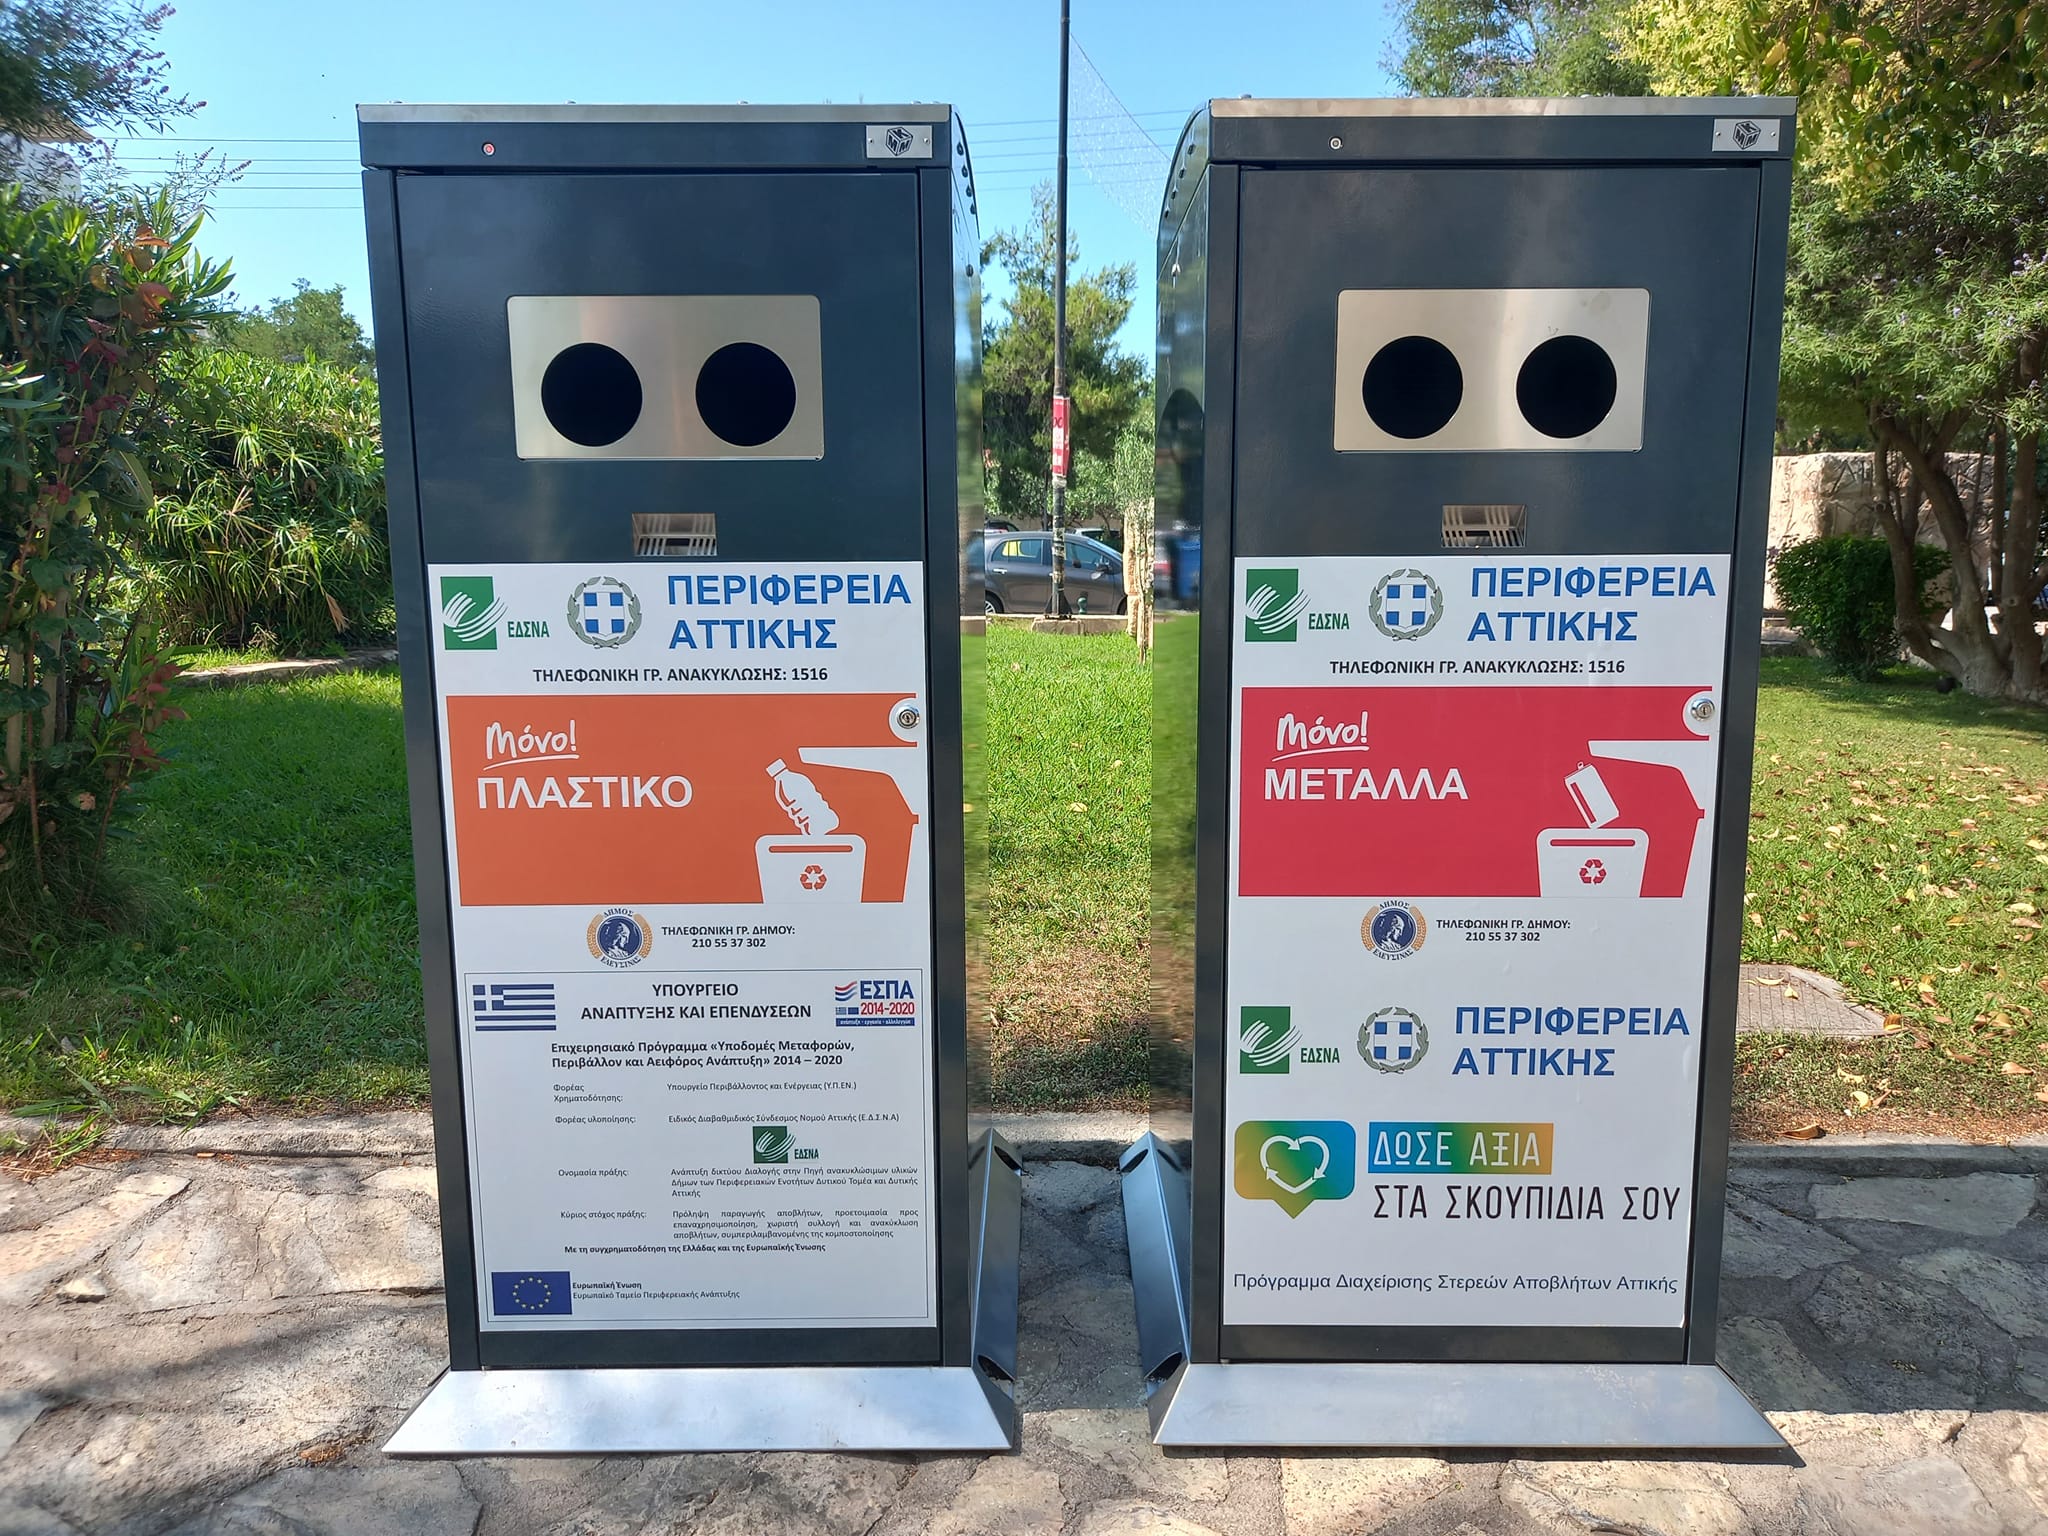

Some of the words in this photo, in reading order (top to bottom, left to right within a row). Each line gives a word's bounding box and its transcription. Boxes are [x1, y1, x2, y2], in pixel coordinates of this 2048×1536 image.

[1472, 567, 1715, 597] ΠΕΡΙΦΕΡΕΙΑ
[668, 575, 911, 605] ΠΕΡΙΦΕΡΕΙΑ
[1309, 613, 1349, 629] ΕΔΣΝΑ
[1467, 612, 1637, 641] ΑΤΤΙΚΗΣ
[508, 621, 549, 637] ΕΔΣΝΑ
[669, 619, 837, 649] ΑΤΤΙΚΗΣ
[1330, 661, 1434, 674] ΤΗΛΕΦΩΝΙΚΗ
[1440, 661, 1458, 673] ΓΡ.
[1463, 661, 1583, 673] ΑΝΑΚΥΚΛΩΣΗΣ:
[1589, 661, 1624, 673] 1516
[533, 669, 638, 682] ΤΗΛΕΦΩΝΙΚΗ
[644, 669, 662, 681] ΓΡ.
[668, 668, 786, 681] ΑΝΑΚΥΚΛΩΣΗΣ:
[792, 668, 827, 680] 1516
[1276, 711, 1369, 752] Μόνο!
[485, 719, 577, 761] Μόνο!
[1264, 768, 1468, 801] ΜΕΤΑΛΛΑ
[477, 774, 693, 809] ΠΛΑΣΤΙΚΟ
[1379, 900, 1411, 910] ΔΗΜΟΣ
[603, 907, 635, 918] ΔΗΜΟΣ
[1436, 920, 1508, 928] ΤΗΛΕΦΩΝΙΚΗ
[1512, 920, 1524, 928] ΓΡ.
[1527, 920, 1570, 928] ΔΗΜΟΥ:
[662, 926, 733, 935] ΤΗΛΕΦΩΝΙΚΗ
[737, 926, 749, 934] ΓΡ.
[753, 926, 795, 934] ΔΗΜΟΥ:
[1466, 932, 1485, 941] 210
[1488, 932, 1501, 941] 55
[1505, 932, 1517, 941] 37
[1521, 932, 1540, 941] 302
[692, 939, 711, 947] 210
[715, 939, 727, 947] 55
[731, 938, 743, 947] 37
[747, 938, 766, 947] 302
[1372, 949, 1415, 961] ΕΛΕΥΣΙΝΑΣ
[600, 956, 642, 968] ΕΛΕΥΣΙΝΑΣ
[652, 984, 738, 996] ΥΠΟΥΡΓΕΙΟ
[860, 980, 914, 999] ΕΣΠΑ
[581, 1007, 675, 1019] ΑΝΑΠΤΥΞΗΣ
[680, 1006, 704, 1018] ΚΑΙ
[710, 1005, 810, 1018] ΕΠΕΝΔΥΣΕΩΝ
[860, 1002, 915, 1015] 2014-2020
[1456, 1007, 1689, 1035] ΠΕΡΙΦΕΡΕΙΑ
[552, 1042, 635, 1054] Επιχειρησιακό
[639, 1041, 707, 1054] Πρόγραμμα
[711, 1040, 775, 1052] «Υποδομές
[779, 1040, 854, 1052] Μεταφορών,
[1301, 1048, 1340, 1063] ΕΔΣΝΑ
[553, 1057, 622, 1069] Περιβάλλον
[647, 1055, 703, 1068] Αειφόρος
[706, 1055, 769, 1067] Ανάπτυξη»
[774, 1056, 801, 1065] 2014
[815, 1055, 842, 1064] 2020
[1452, 1048, 1615, 1076] ΑΤΤΙΚΗΣ
[553, 1084, 584, 1092] Φορέας
[667, 1083, 708, 1092] Υπουργείο
[710, 1082, 768, 1091] Περιβάλλοντος
[784, 1082, 822, 1091] Ενέργειας
[824, 1082, 856, 1090] (Υ.Π.ΕΝ.)
[554, 1094, 623, 1103] Χρηματοδότησης:
[555, 1116, 586, 1124] Φορέας
[588, 1116, 636, 1124] υλοποίησης:
[669, 1115, 696, 1123] Ειδικός
[698, 1115, 755, 1123] Διαβαθμιδικός
[756, 1114, 798, 1122] Σύνδεσμος
[800, 1114, 825, 1122] Νομού
[828, 1114, 856, 1122] Αττικής
[859, 1114, 899, 1122] (Ε.Δ.Σ.Ν.Α)
[795, 1149, 818, 1159] ΕΔΣΝΑ
[1373, 1131, 1453, 1166] ΔΩΣΕ
[1469, 1131, 1540, 1166] ΑΞΙΑ
[559, 1169, 596, 1177] Ονομασία
[599, 1168, 627, 1177] πράξης:
[671, 1168, 708, 1176] Ανάπτυξη
[745, 1167, 780, 1176] Διαλογής
[804, 1167, 823, 1176] Πηγή
[827, 1167, 888, 1175] ανακυκλώσιμων
[672, 1179, 697, 1187] Δήμων
[717, 1178, 775, 1187] Περιφερειακών
[778, 1178, 814, 1186] Ενοτήτων
[849, 1177, 872, 1186] Τομέα
[888, 1177, 918, 1185] Δυτικής
[672, 1190, 700, 1198] Αττικής
[1374, 1185, 1427, 1218] ΣΤΑ
[1446, 1186, 1603, 1219] ΣΚΟΥΠΙΔΙΑ
[1623, 1187, 1680, 1220] ΣΟΥ
[561, 1211, 587, 1219] Κύριος
[589, 1211, 615, 1219] στόχος
[617, 1210, 646, 1219] πράξης:
[673, 1210, 709, 1219] Πρόληψη
[722, 1210, 765, 1218] παραγωγής
[777, 1209, 822, 1217] αποβλήτων,
[835, 1209, 887, 1217] προετοιμασία
[673, 1220, 758, 1229] επαναχρησιμοποίηση,
[767, 1220, 798, 1228] χωριστή
[808, 1219, 840, 1228] συλλογή
[870, 1219, 918, 1227] ανακύκλωση
[674, 1231, 719, 1240] αποβλήτων,
[722, 1230, 809, 1239] συμπεριλαμβανομένης
[825, 1230, 893, 1238] κομποστοποίησης
[590, 1245, 666, 1254] συγχρηματοδότηση
[683, 1244, 716, 1252] Ελλάδας
[747, 1243, 796, 1252] Ευρωπαϊκής
[573, 1281, 615, 1290] Ευρωπαϊκή
[1234, 1274, 1330, 1291] Πρόγραμμα
[1336, 1274, 1432, 1292] Διαχείρισης
[1438, 1275, 1508, 1292] Στερεών
[1513, 1276, 1611, 1293] Αποβλήτων
[1617, 1276, 1677, 1293] Αττικής
[573, 1291, 614, 1299] Ευρωπαϊκό
[644, 1291, 699, 1299] Περιφερειακής
[700, 1290, 740, 1298] Ανάπτυξης
